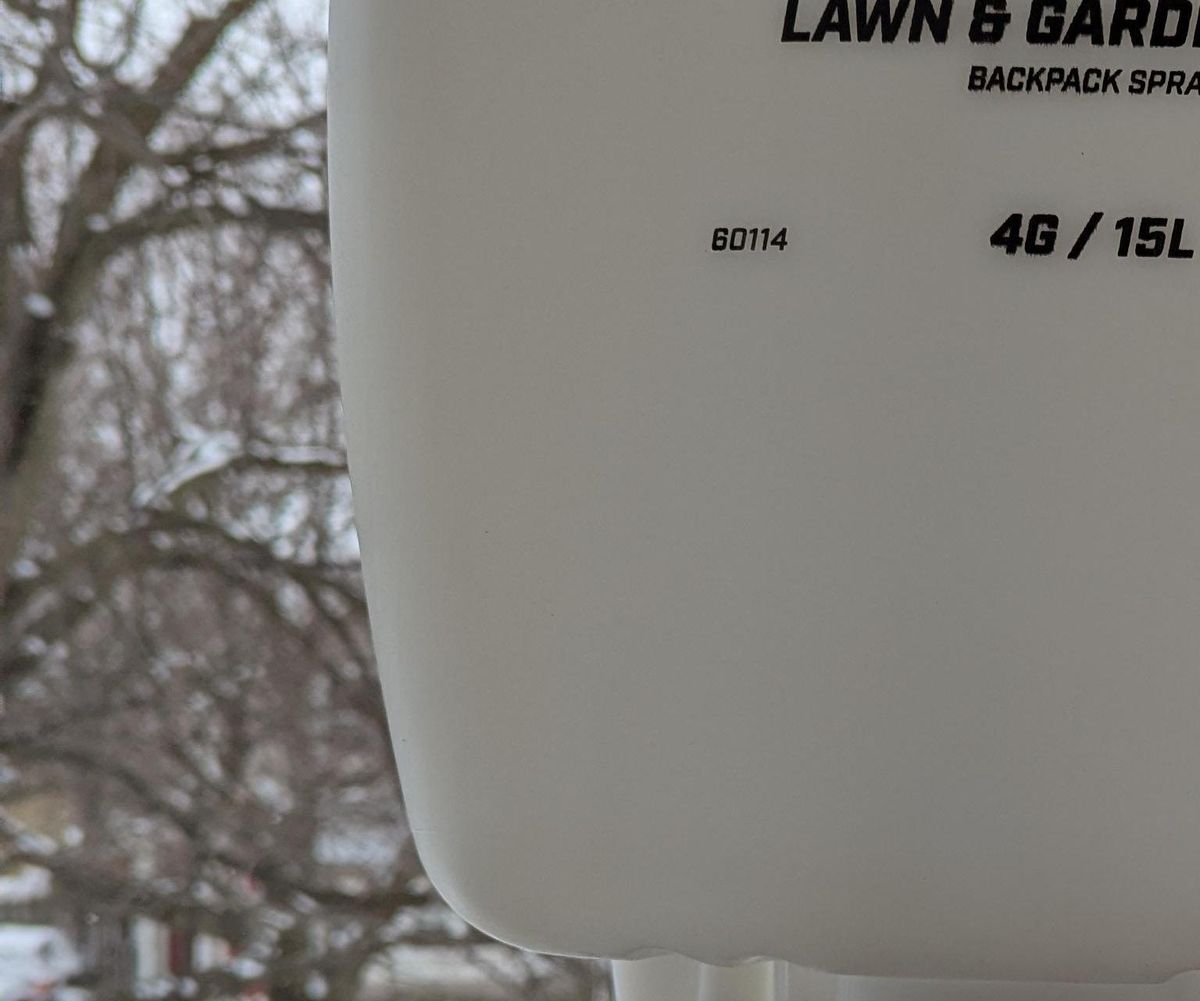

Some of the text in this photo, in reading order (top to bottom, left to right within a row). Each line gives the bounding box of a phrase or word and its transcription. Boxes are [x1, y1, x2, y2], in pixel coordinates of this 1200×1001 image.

[780, 0, 954, 44] LAWN
[967, 0, 1012, 45] &
[967, 66, 1124, 95] BACKPACK
[711, 227, 788, 252] 60114
[989, 211, 1195, 260] 4G / 15L
